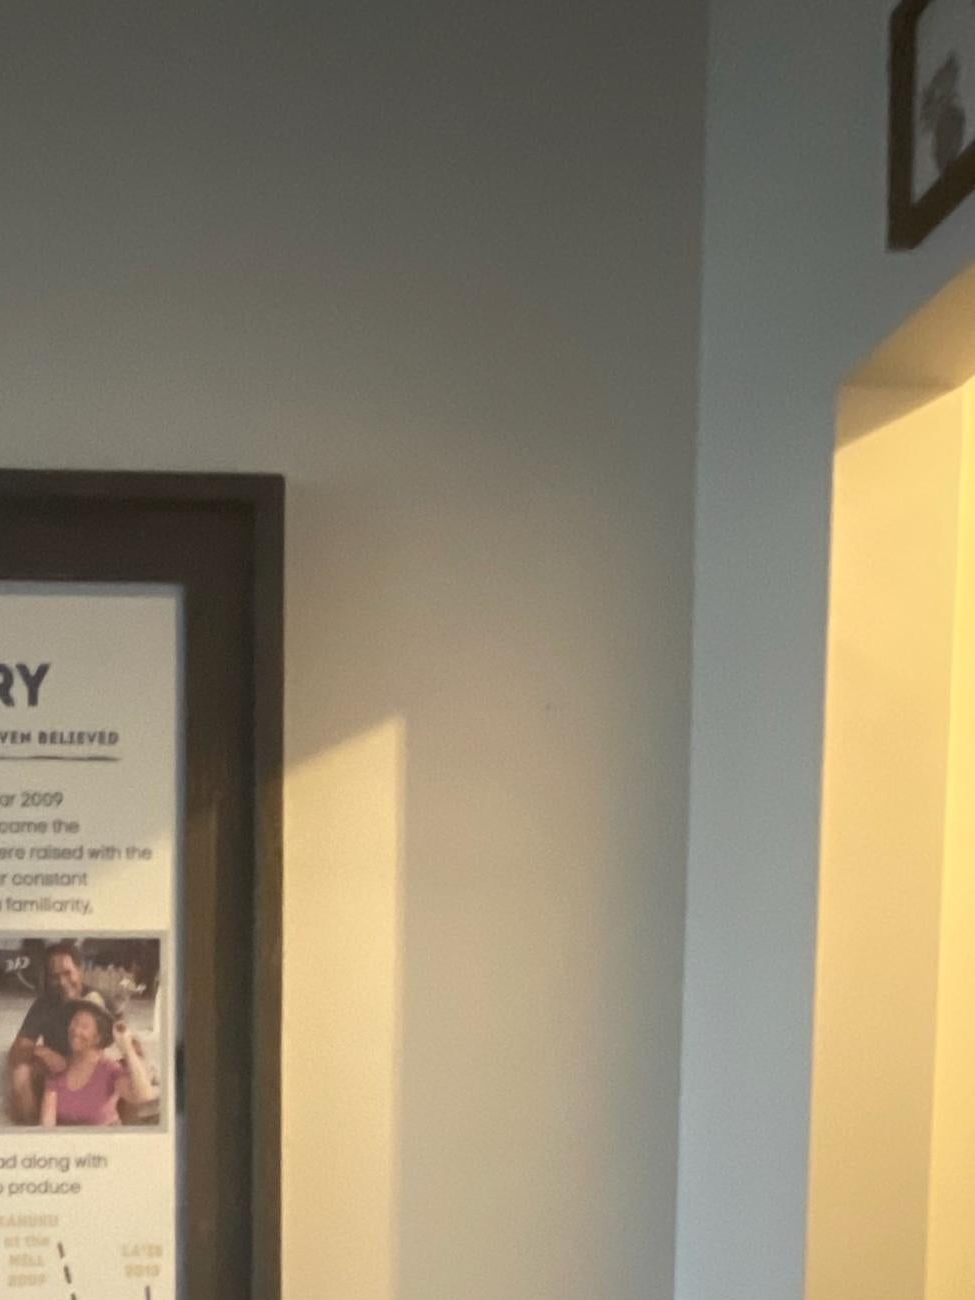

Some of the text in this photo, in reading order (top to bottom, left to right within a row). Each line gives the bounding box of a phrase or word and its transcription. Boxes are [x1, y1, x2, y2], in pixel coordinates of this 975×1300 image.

[38, 731, 119, 745] BELIEVED
[21, 791, 64, 808] 2009
[29, 845, 84, 860] raised
[88, 846, 121, 859] with
[126, 846, 152, 860] the
[11, 873, 87, 886] constant
[21, 1155, 71, 1174] along
[74, 1154, 108, 1168] with
